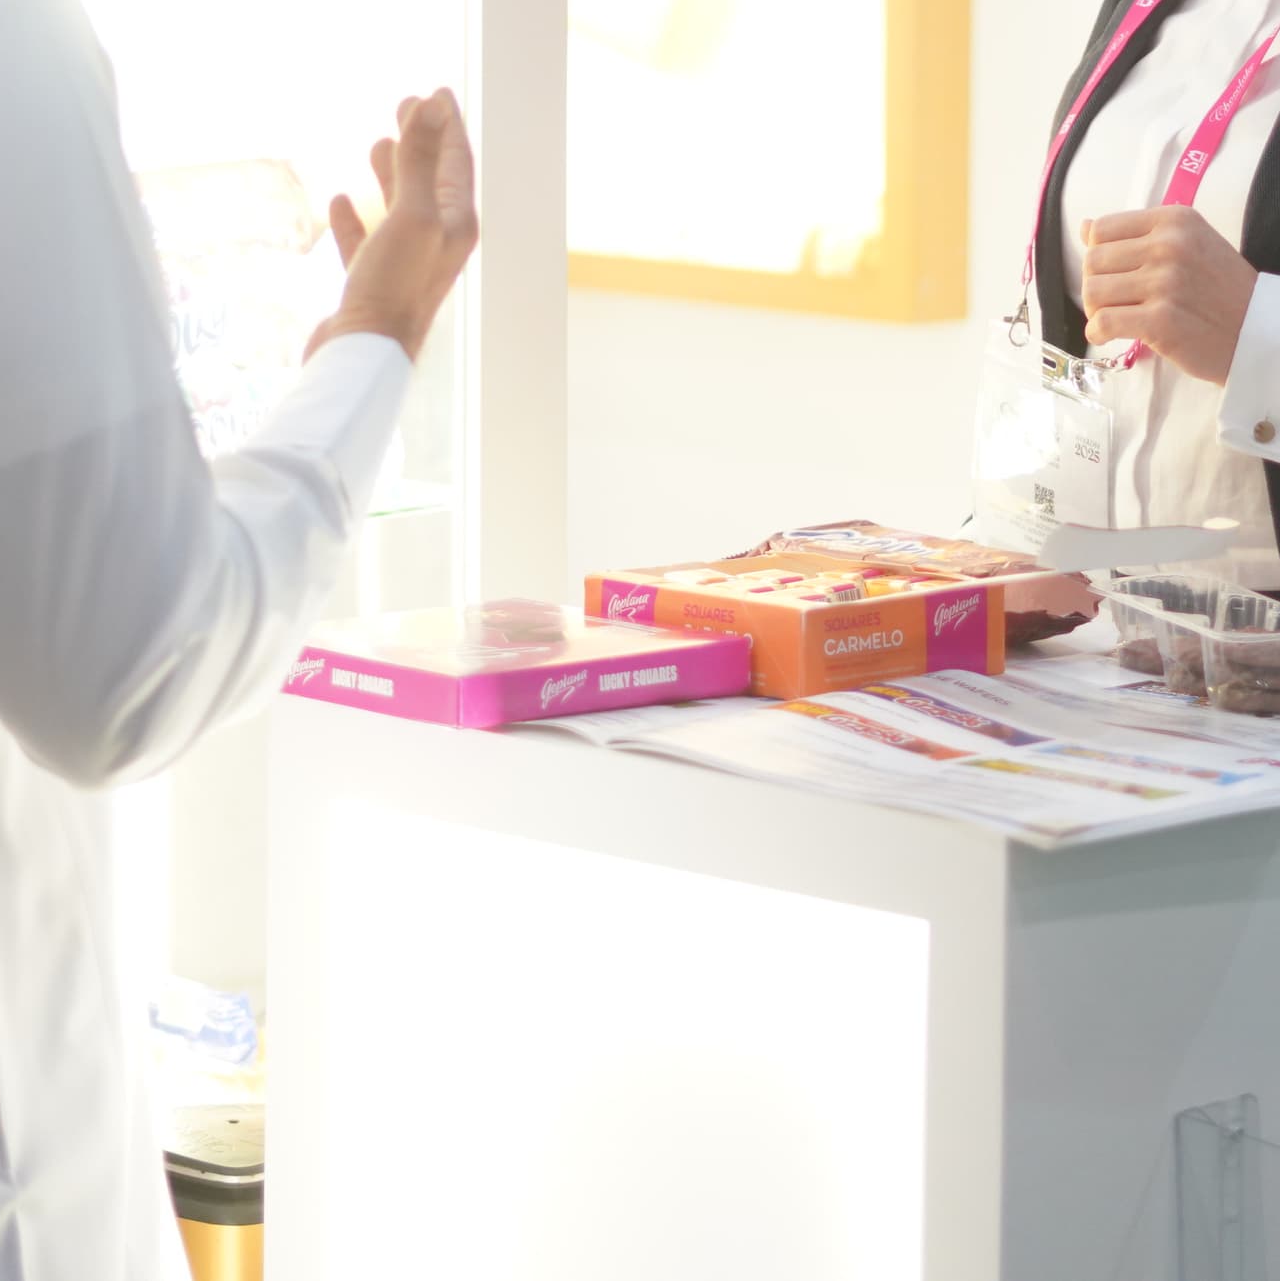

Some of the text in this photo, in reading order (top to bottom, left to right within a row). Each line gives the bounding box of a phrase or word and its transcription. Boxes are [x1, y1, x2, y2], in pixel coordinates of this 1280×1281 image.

[1180, 150, 1205, 174] ISM
[1074, 442, 1101, 463] 2025
[683, 603, 736, 624] SQUARES
[823, 611, 881, 633] SQUARES
[933, 593, 981, 637] Goplana
[823, 629, 904, 657] CARMELO
[331, 667, 394, 698] LUCKY SQUARES
[541, 669, 588, 711] Goplana
[599, 665, 678, 692] LUCKY SQUARES
